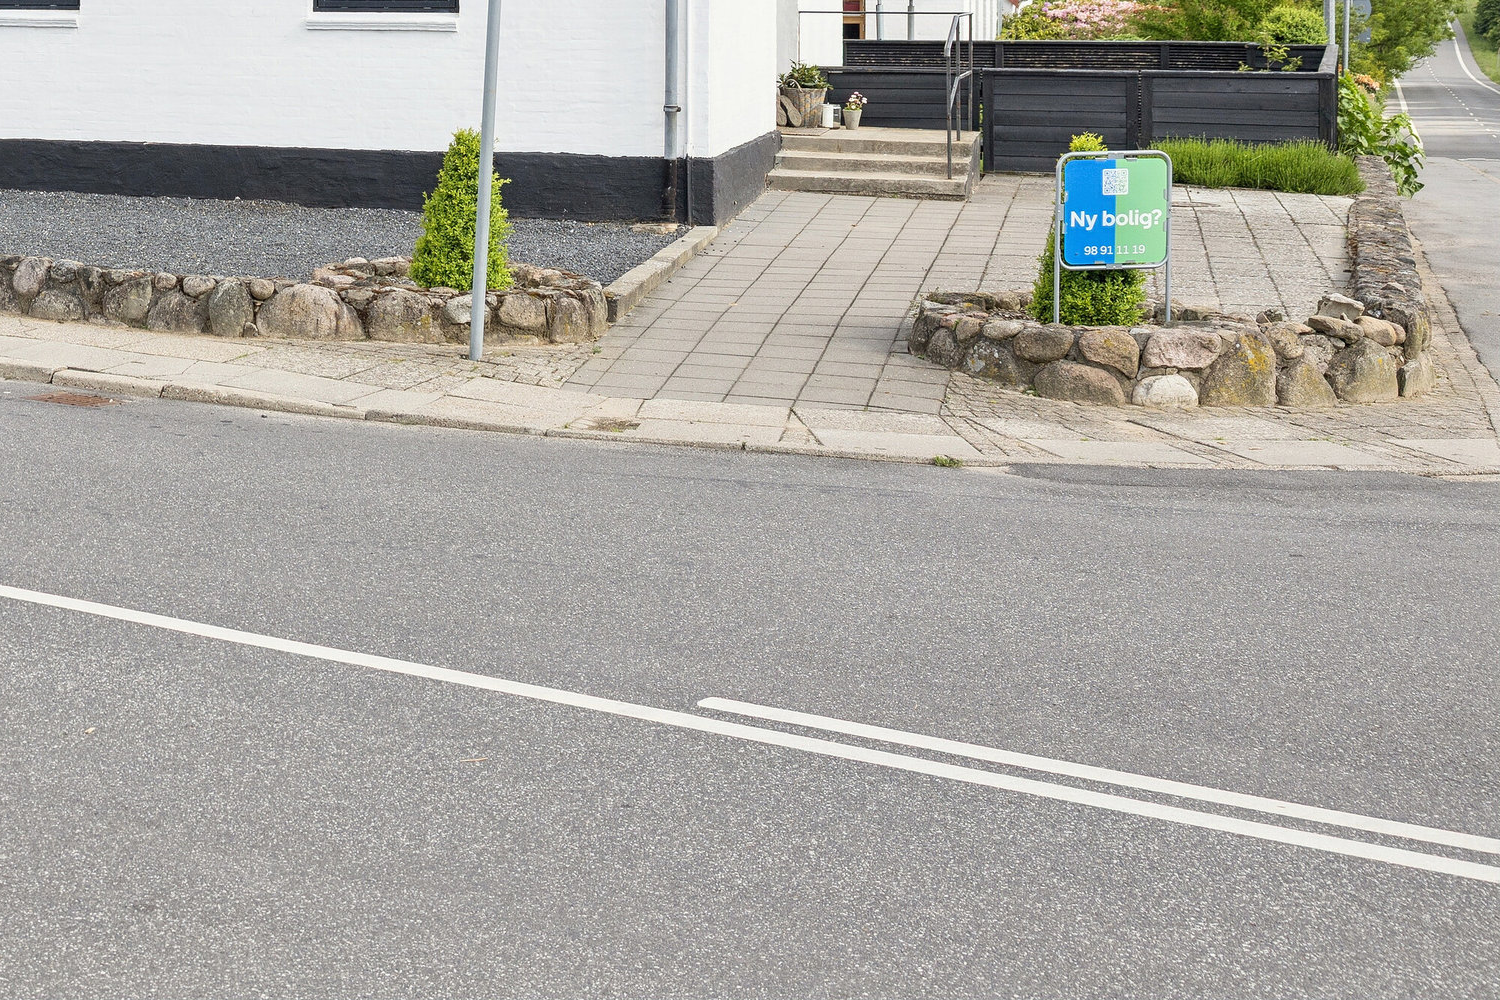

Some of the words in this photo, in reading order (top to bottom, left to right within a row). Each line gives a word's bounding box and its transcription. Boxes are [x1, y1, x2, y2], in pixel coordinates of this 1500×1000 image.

[1070, 210, 1098, 231] Ny
[1102, 208, 1163, 230] bolig?
[1083, 245, 1098, 256] 98
[1100, 245, 1114, 255] 91
[1116, 245, 1129, 255] 11
[1132, 244, 1146, 254] 19
